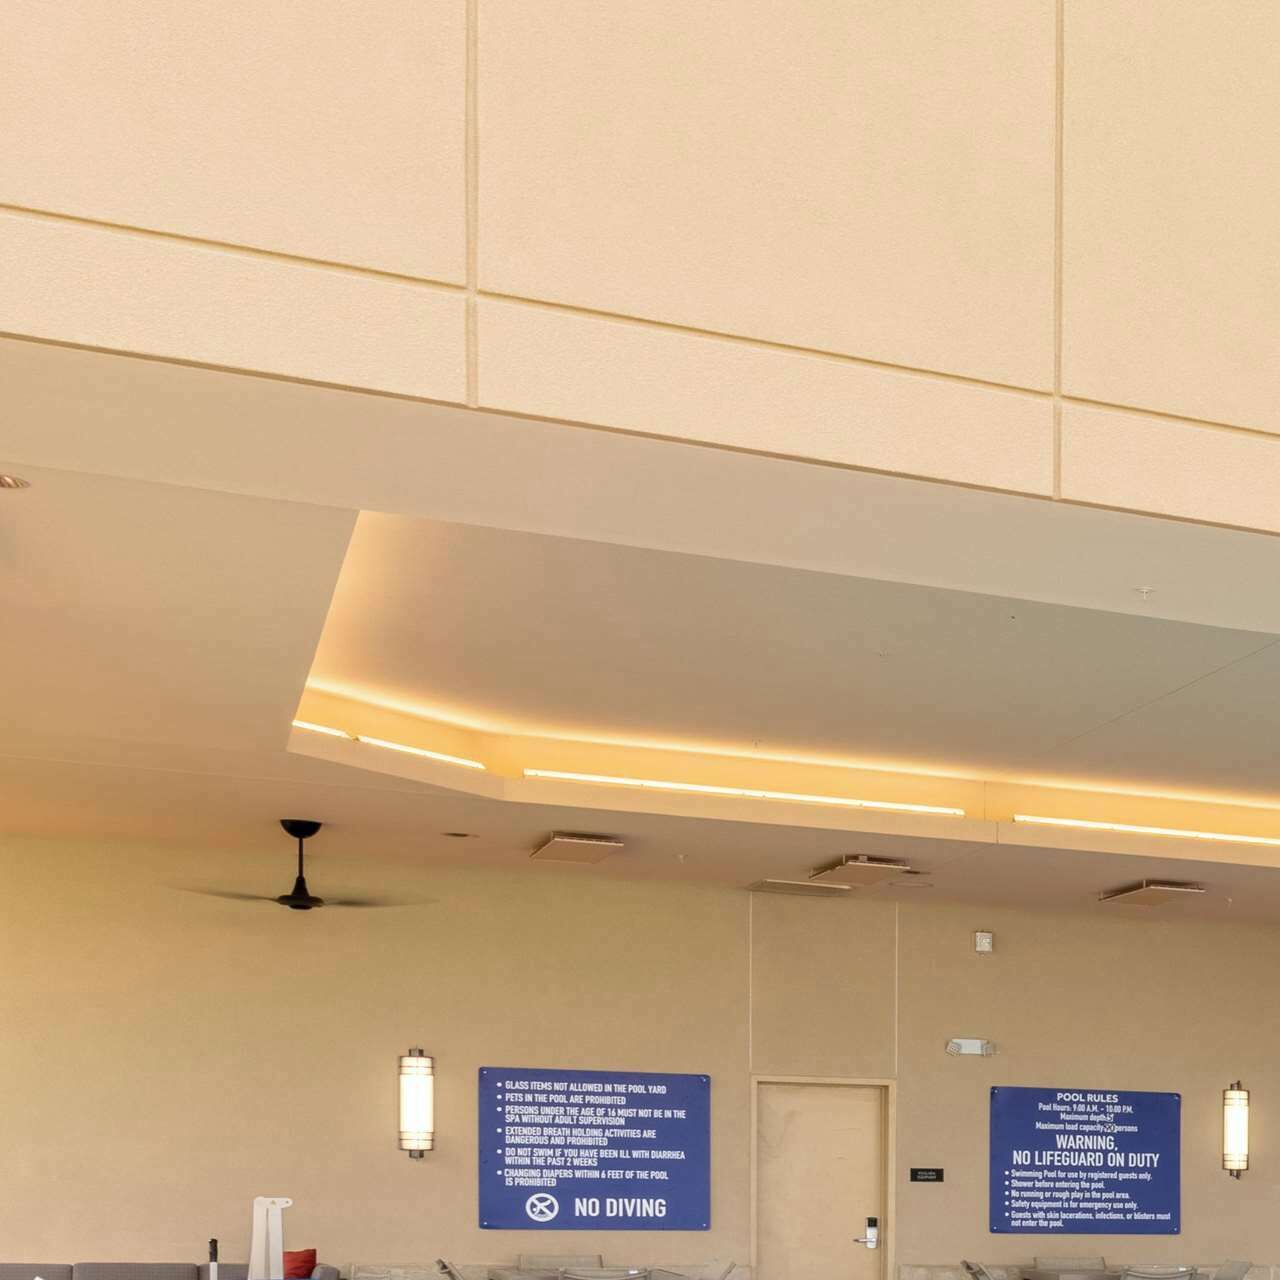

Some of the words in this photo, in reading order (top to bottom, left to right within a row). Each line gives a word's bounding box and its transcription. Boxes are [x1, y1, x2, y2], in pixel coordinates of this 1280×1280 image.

[505, 1081, 529, 1090] GLASS
[530, 1082, 552, 1090] ITEMS
[554, 1082, 568, 1091] NOT
[569, 1083, 602, 1092] ALLOWED
[605, 1084, 613, 1092] IN
[614, 1084, 627, 1093] THE
[628, 1085, 646, 1093] POOL
[648, 1086, 666, 1094] YARD
[506, 1093, 523, 1101] PETS
[525, 1094, 532, 1102] IN
[534, 1094, 548, 1102] THE
[549, 1095, 568, 1103] POOL
[569, 1095, 584, 1104] ARE
[585, 1096, 626, 1104] PROHIBITED
[1057, 1093, 1085, 1102] POOL
[1087, 1094, 1118, 1103] RULES
[505, 1106, 538, 1115] PERSONS
[540, 1106, 565, 1115] UNDER
[566, 1107, 579, 1116] THE
[580, 1108, 595, 1116] AGE
[596, 1108, 605, 1116] OF
[608, 1108, 616, 1116] 16
[618, 1109, 637, 1117] MUST
[638, 1109, 652, 1117] NOT
[654, 1110, 663, 1118] BE
[664, 1110, 672, 1118] IN
[673, 1110, 686, 1118] THE
[505, 1115, 520, 1123] SPA
[522, 1115, 553, 1124] WITHOUT
[554, 1116, 577, 1124] ADULT
[579, 1116, 625, 1125] SUPERVISION
[505, 1127, 541, 1135] EXTENDED
[543, 1127, 570, 1136] BREATH
[572, 1128, 603, 1137] HOLDING
[604, 1129, 641, 1138] ACTIVITIES
[642, 1130, 656, 1138] ARE
[506, 1136, 548, 1144] DANGEROUS
[550, 1137, 565, 1145] AND
[567, 1137, 608, 1146] PROHIBITED
[506, 1148, 516, 1156] DO
[517, 1148, 531, 1156] NOT
[534, 1148, 553, 1156] SWIM
[555, 1149, 561, 1157] IF
[564, 1149, 578, 1157] YOU
[580, 1149, 598, 1157] HAVE
[600, 1150, 618, 1158] BEEN
[620, 1150, 630, 1158] ILL
[632, 1150, 650, 1158] WITH
[651, 1150, 685, 1159] DIARRHEA
[1013, 1150, 1031, 1165] NO
[1035, 1151, 1103, 1166] LIFEGUARD
[1107, 1152, 1124, 1167] ON
[1129, 1153, 1160, 1168] DUTY
[505, 1157, 531, 1165] WITHIN
[532, 1157, 545, 1165] THE
[566, 1158, 571, 1166] 2
[573, 1158, 598, 1166] WEEKS
[504, 1169, 541, 1177] CHANGING
[543, 1169, 573, 1178] DIAPERS
[575, 1170, 599, 1178] WITHIN
[601, 1170, 606, 1179] 6
[607, 1170, 624, 1179] FEET
[625, 1171, 634, 1179] OF
[636, 1171, 649, 1179] THE
[650, 1171, 668, 1179] POOL
[506, 1178, 513, 1186] IS
[515, 1178, 556, 1186] PROHIBITED
[575, 1198, 600, 1217] NO
[606, 1198, 667, 1217] DIVING
